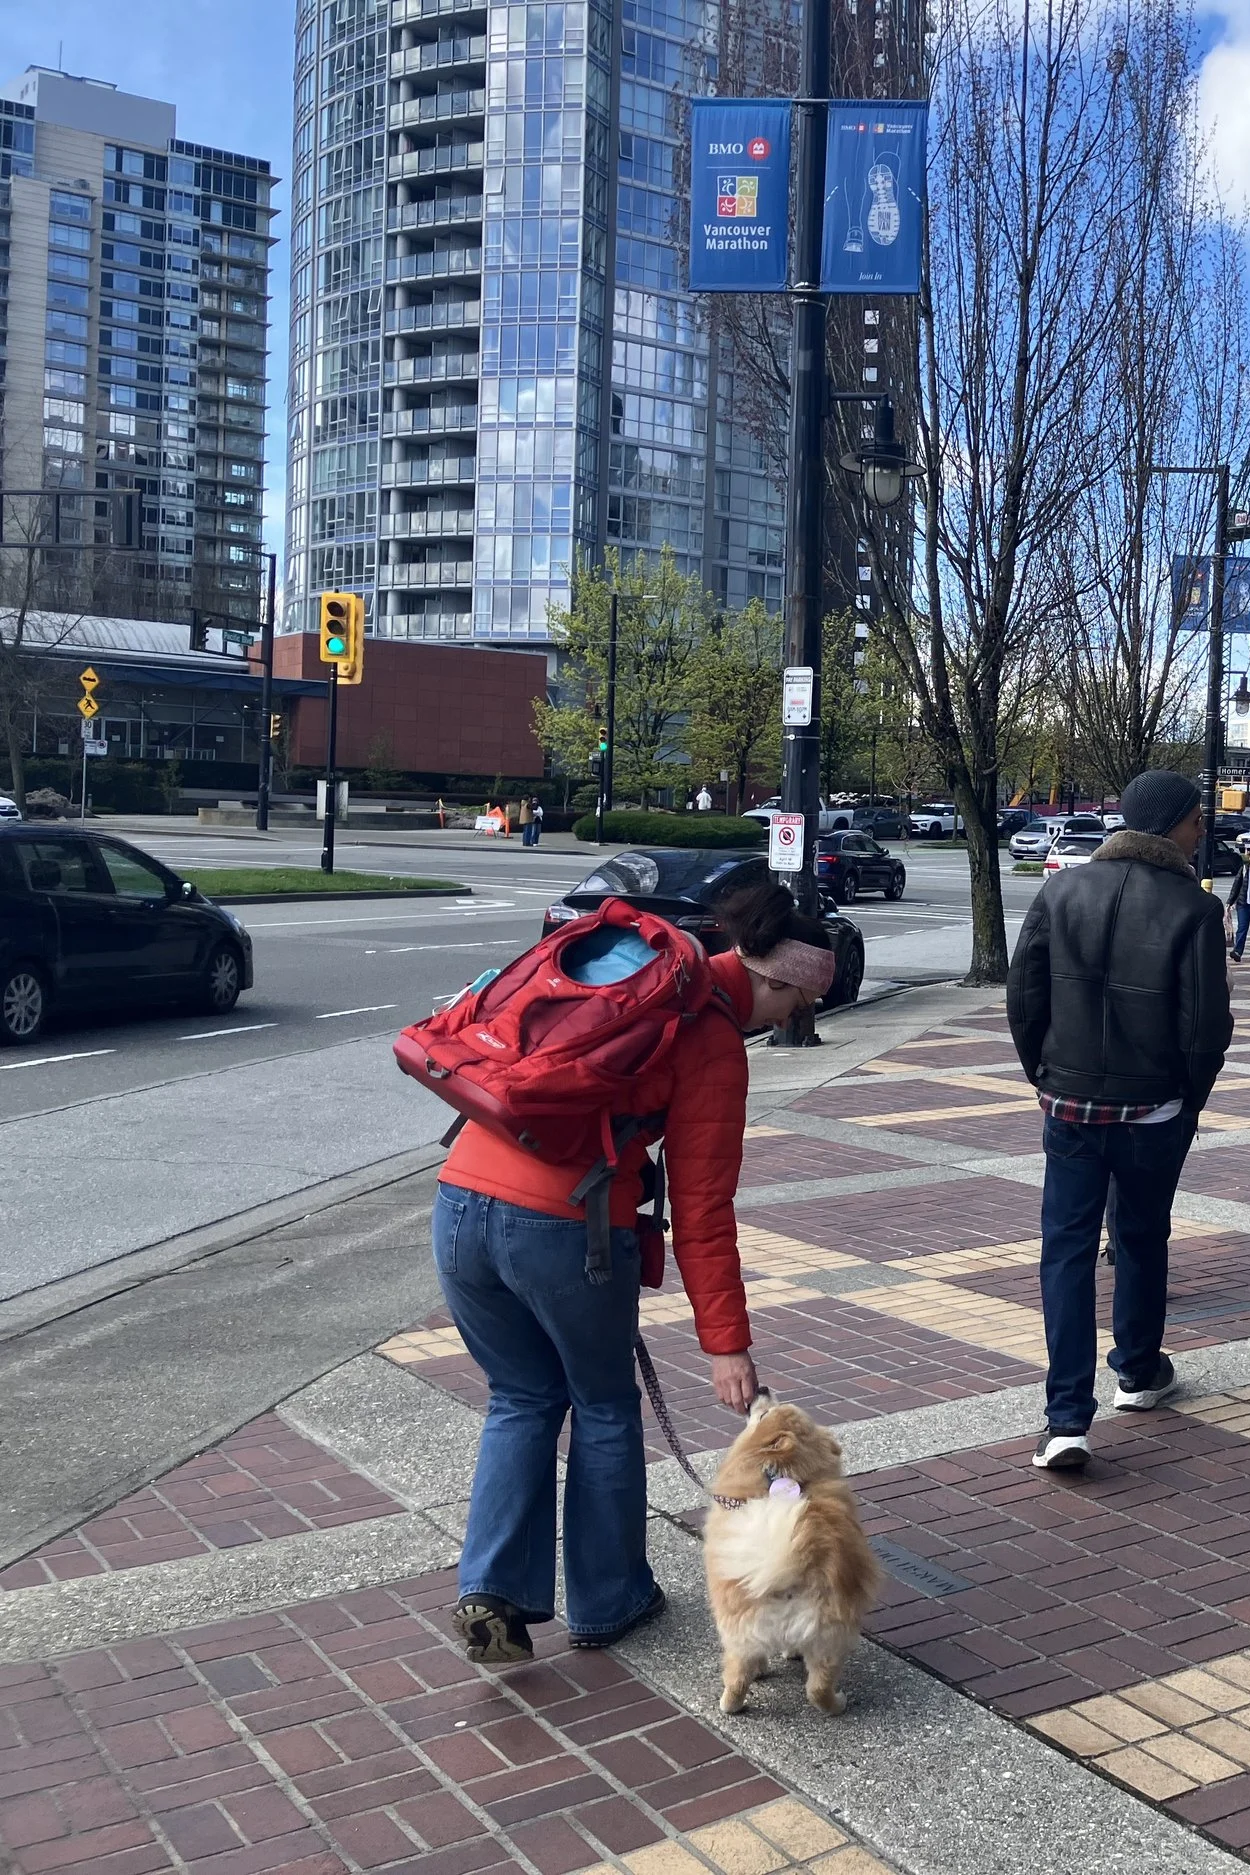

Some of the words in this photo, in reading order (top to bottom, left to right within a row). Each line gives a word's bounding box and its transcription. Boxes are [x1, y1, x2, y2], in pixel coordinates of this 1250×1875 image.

[708, 143, 744, 155] BMO
[703, 224, 771, 236] Vancouver
[705, 237, 768, 250] Marathon
[859, 272, 873, 281] Join
